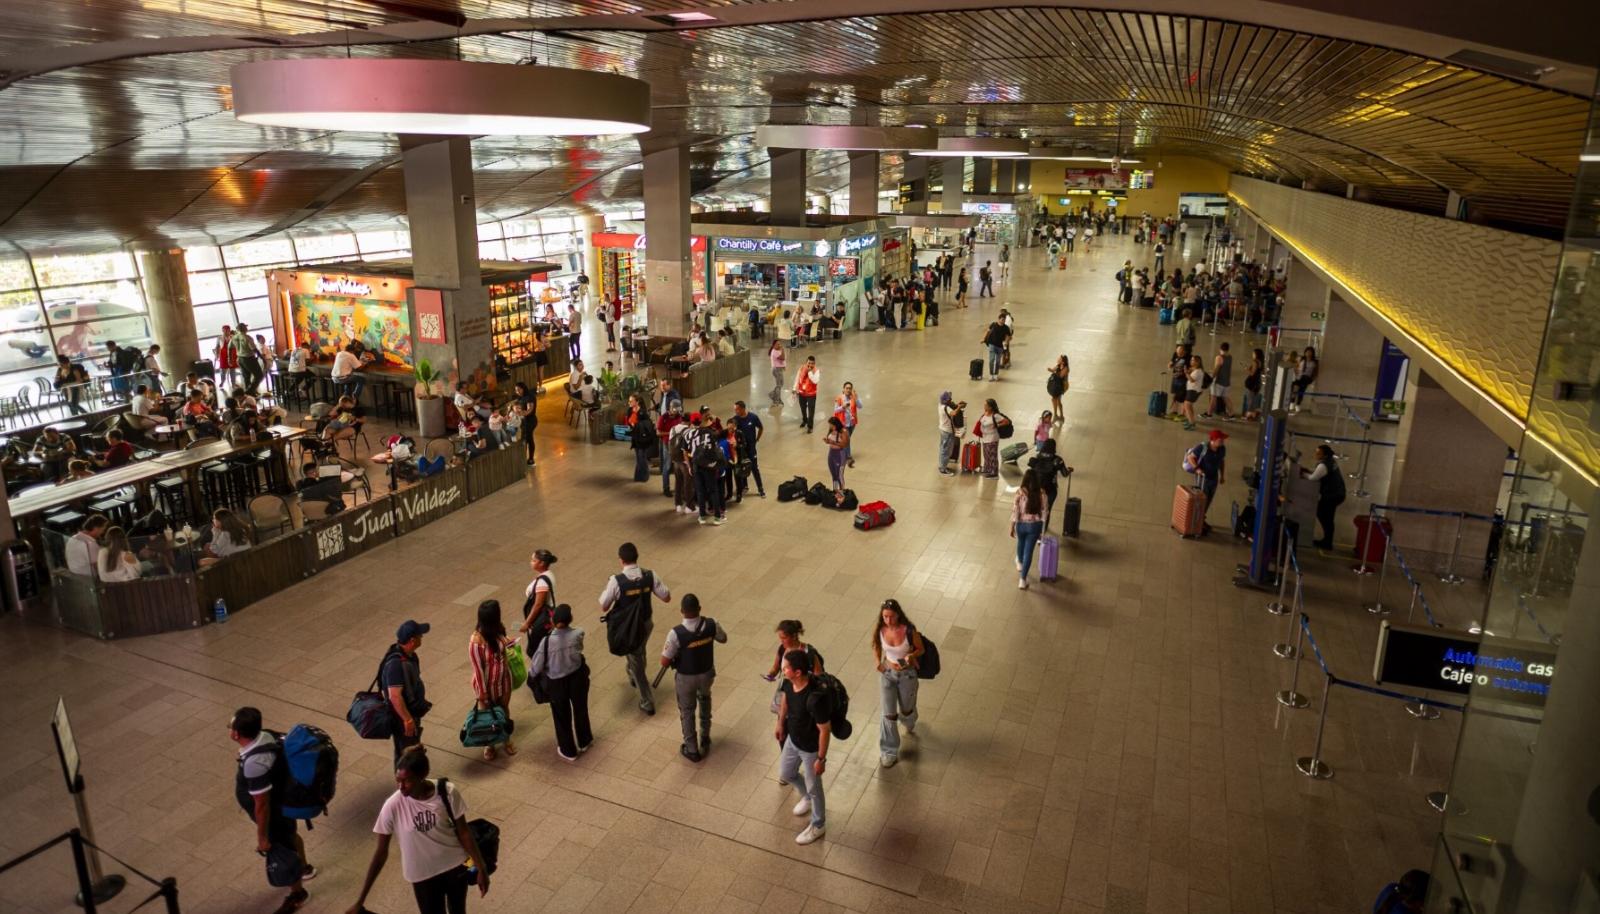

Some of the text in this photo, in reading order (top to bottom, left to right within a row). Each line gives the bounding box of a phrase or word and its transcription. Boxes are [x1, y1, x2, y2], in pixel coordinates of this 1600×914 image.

[719, 238, 758, 251] Chantilly
[759, 240, 782, 251] Café
[349, 485, 461, 542] Juan Valdez
